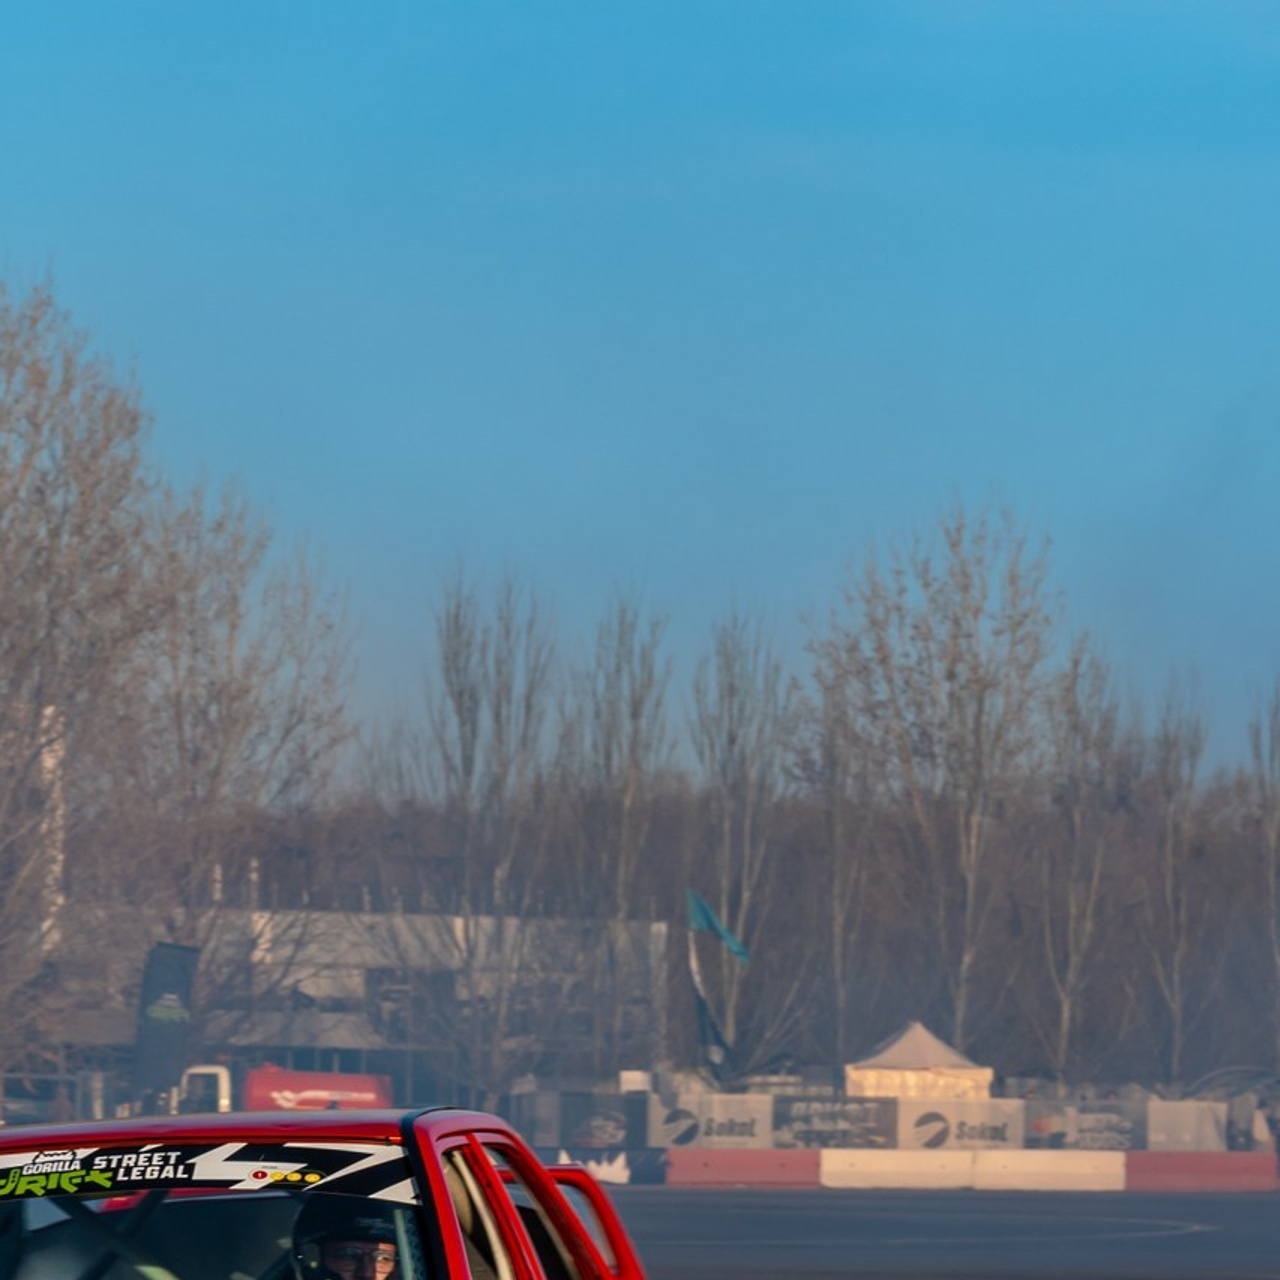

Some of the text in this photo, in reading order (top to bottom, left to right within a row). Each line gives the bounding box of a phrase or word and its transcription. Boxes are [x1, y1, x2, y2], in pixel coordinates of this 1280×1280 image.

[22, 1160, 81, 1176] GORILLA
[92, 1151, 182, 1170] STREET
[116, 1165, 189, 1182] LEGAL
